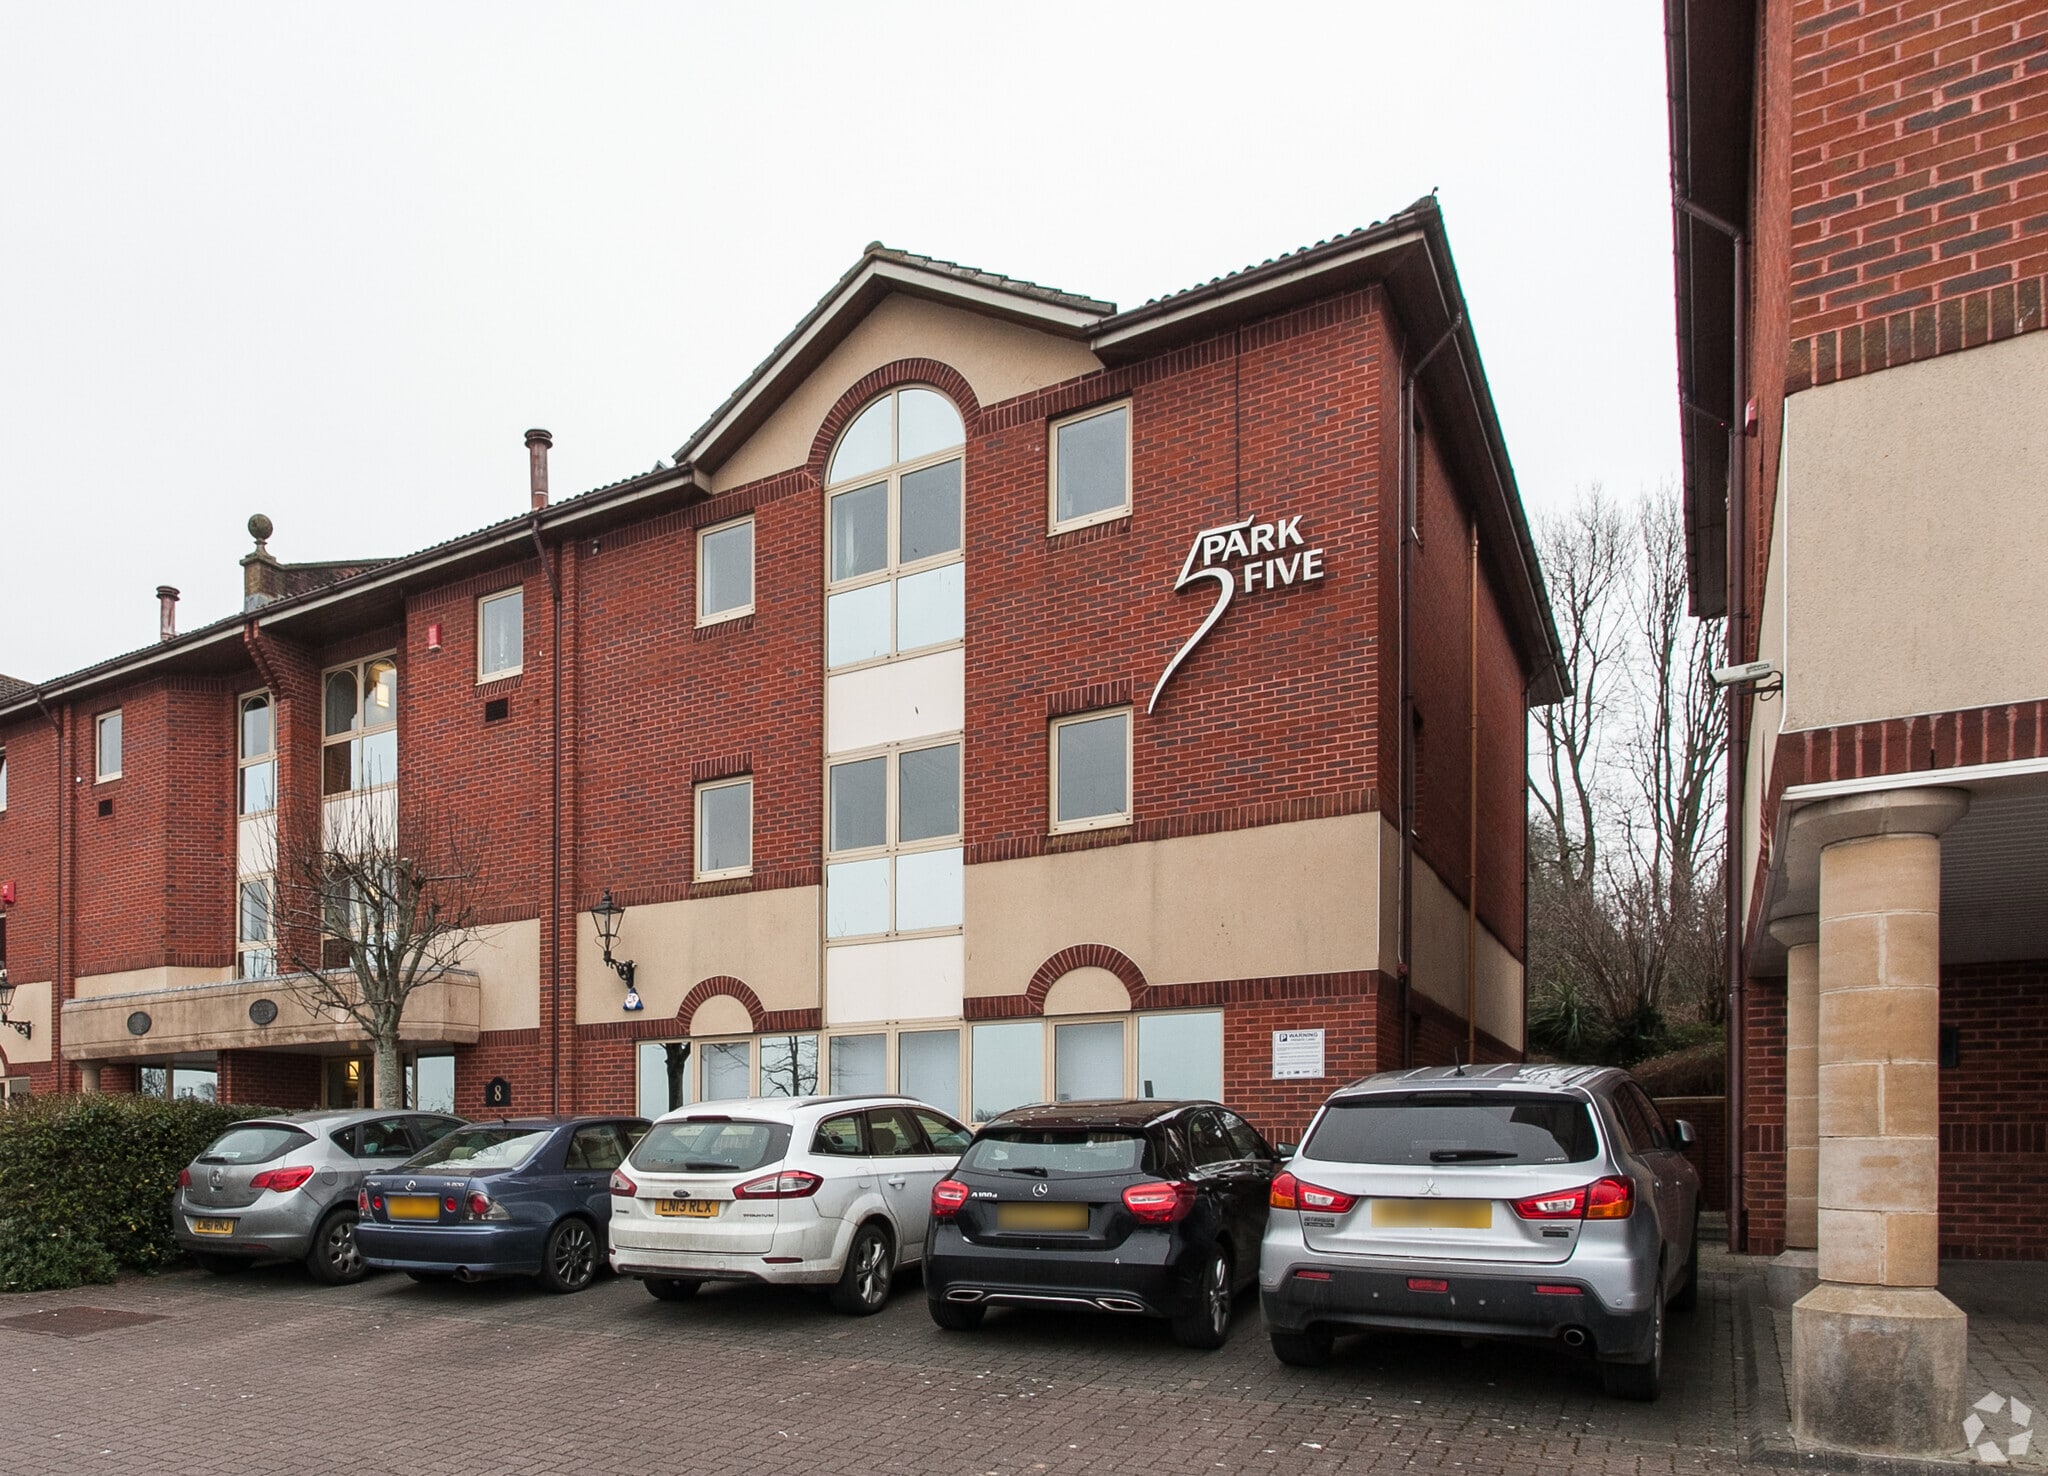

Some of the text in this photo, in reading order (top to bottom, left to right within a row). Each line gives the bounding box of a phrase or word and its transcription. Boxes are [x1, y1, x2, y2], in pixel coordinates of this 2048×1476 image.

[1203, 514, 1304, 566] PARK
[1244, 548, 1324, 593] FIVE
[495, 1085, 501, 1101] 8
[661, 1199, 712, 1213] LN13 RLX
